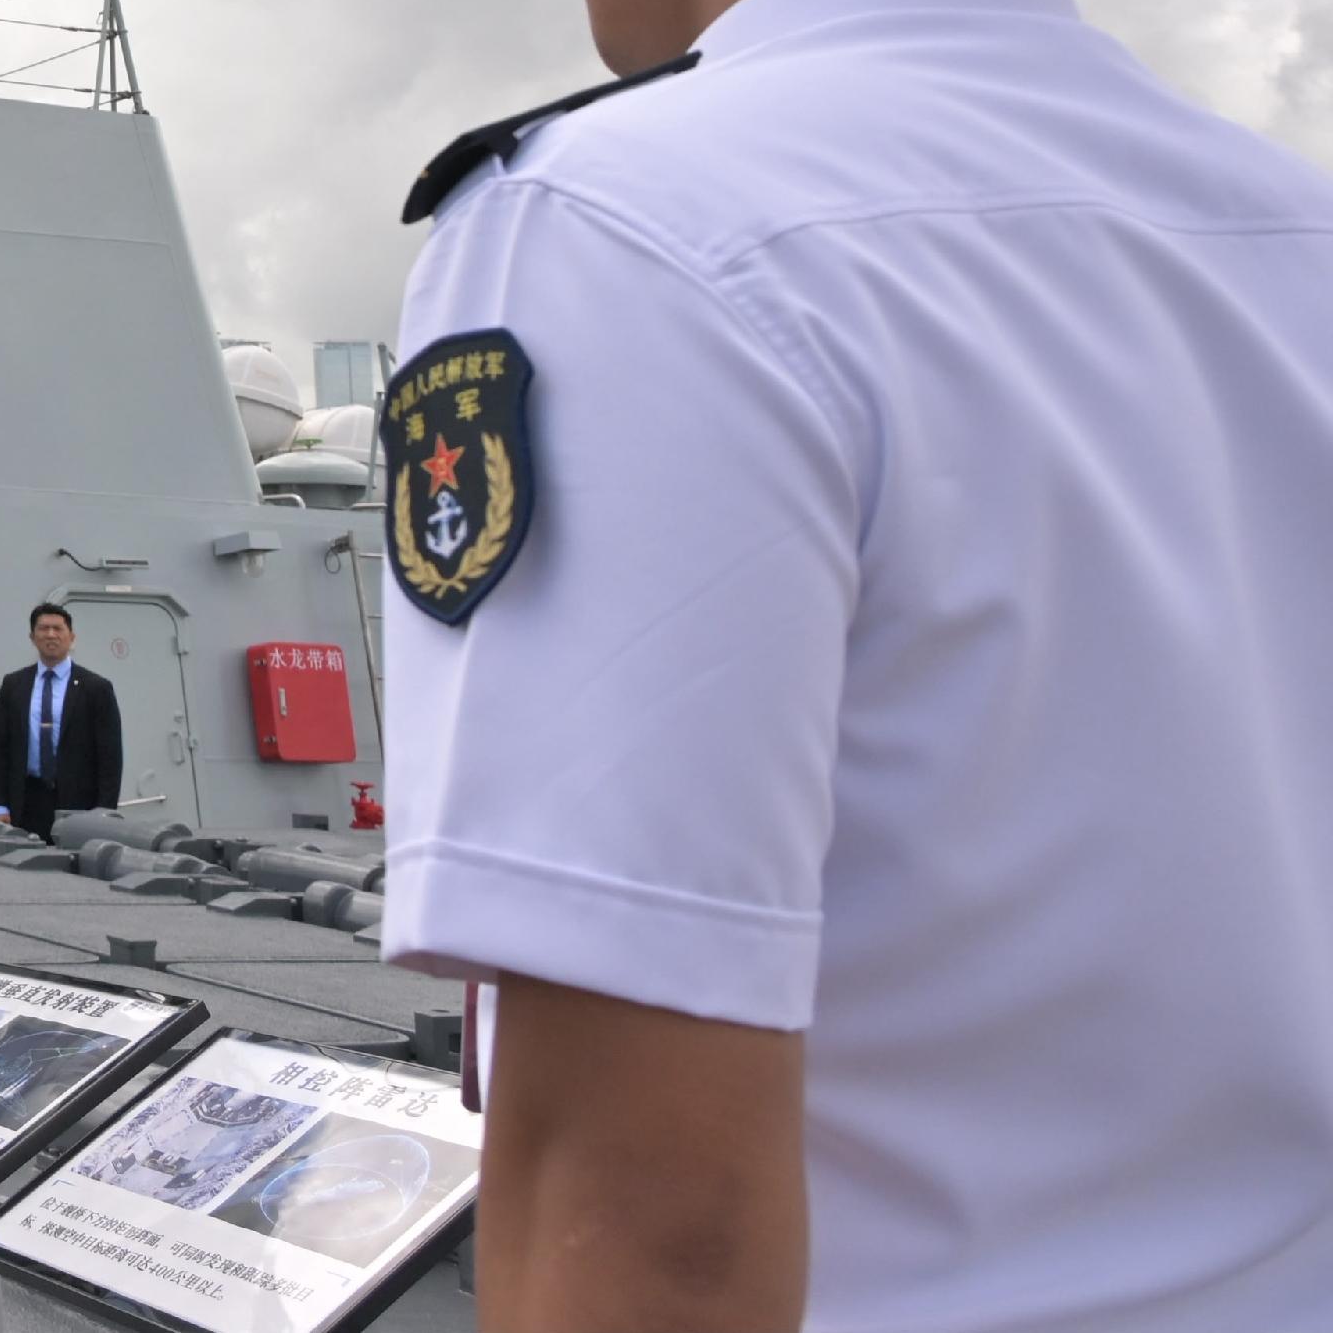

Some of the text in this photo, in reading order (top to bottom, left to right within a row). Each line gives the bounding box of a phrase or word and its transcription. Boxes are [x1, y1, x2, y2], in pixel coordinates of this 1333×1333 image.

[269, 647, 342, 672] 水龙带箱
[269, 1061, 437, 1117] 相控阵雷达
